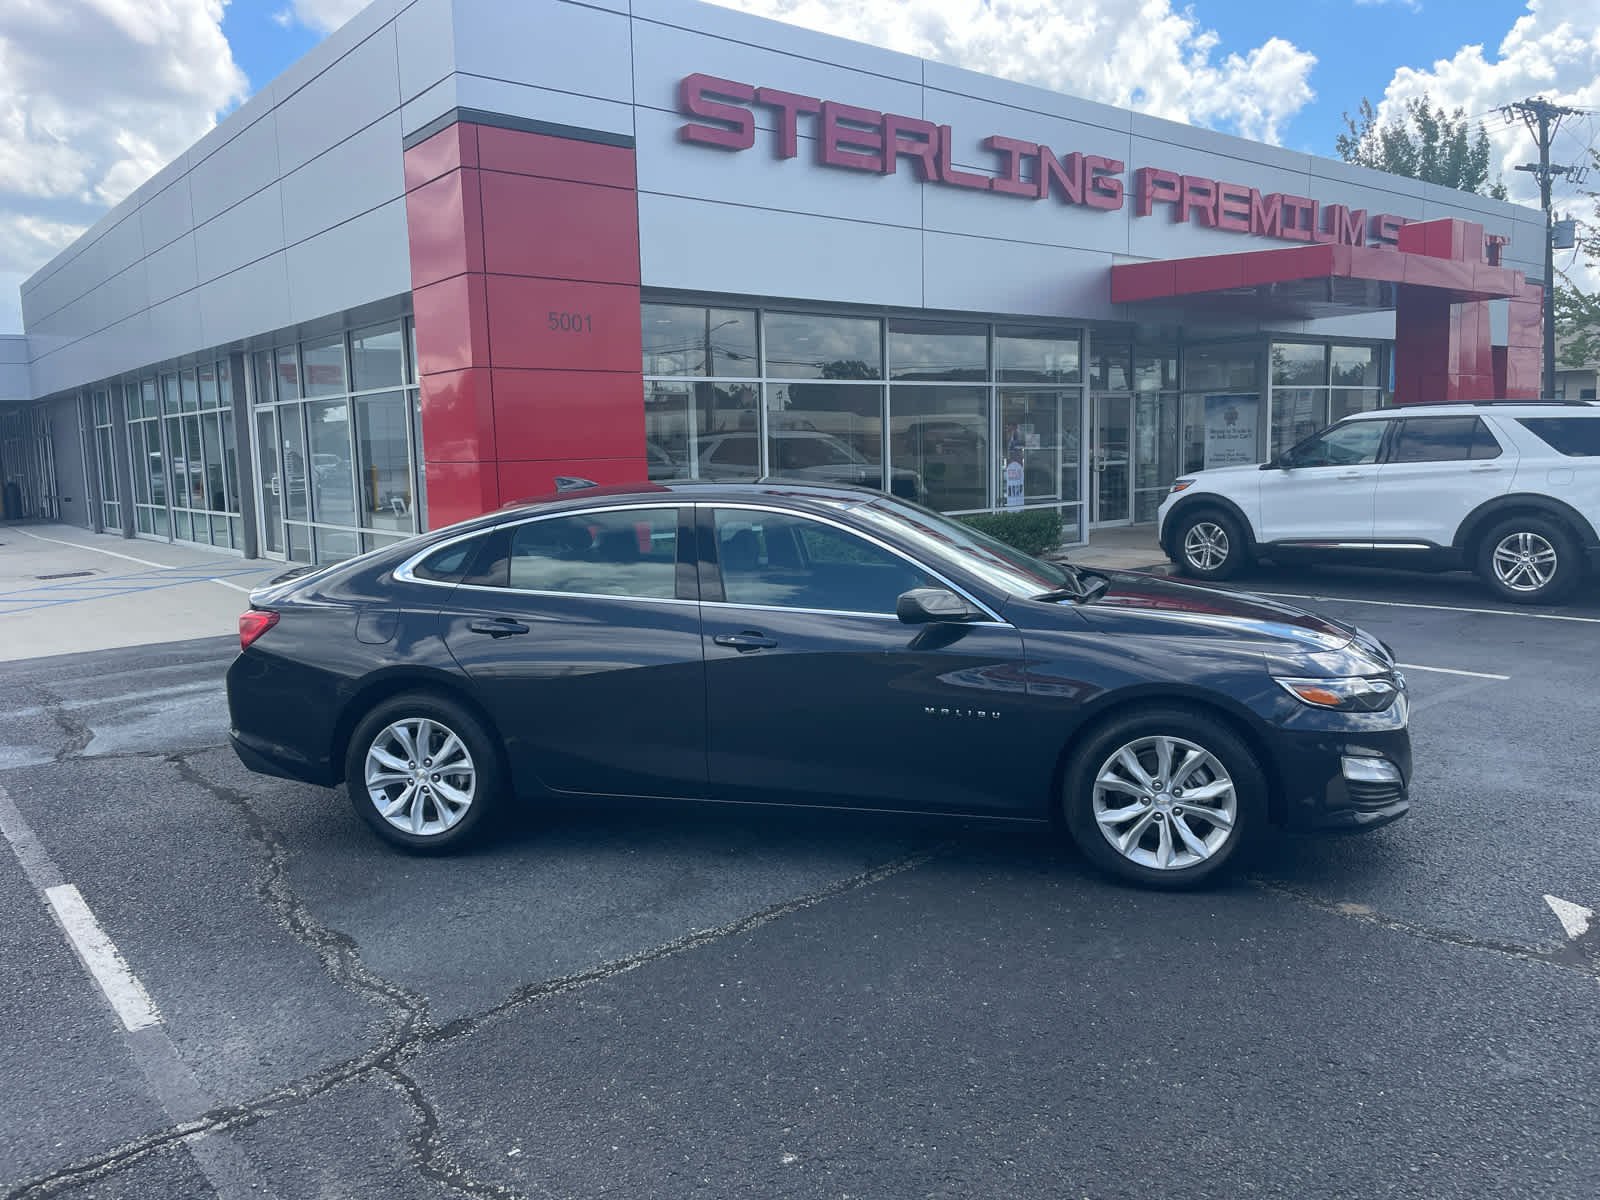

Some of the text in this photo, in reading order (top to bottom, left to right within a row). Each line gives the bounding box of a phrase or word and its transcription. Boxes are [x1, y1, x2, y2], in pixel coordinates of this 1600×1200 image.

[680, 73, 1125, 211] STERLING
[1136, 167, 1367, 248] PREMIUM
[547, 311, 592, 333] 5001
[924, 706, 1001, 719] MALIBU
